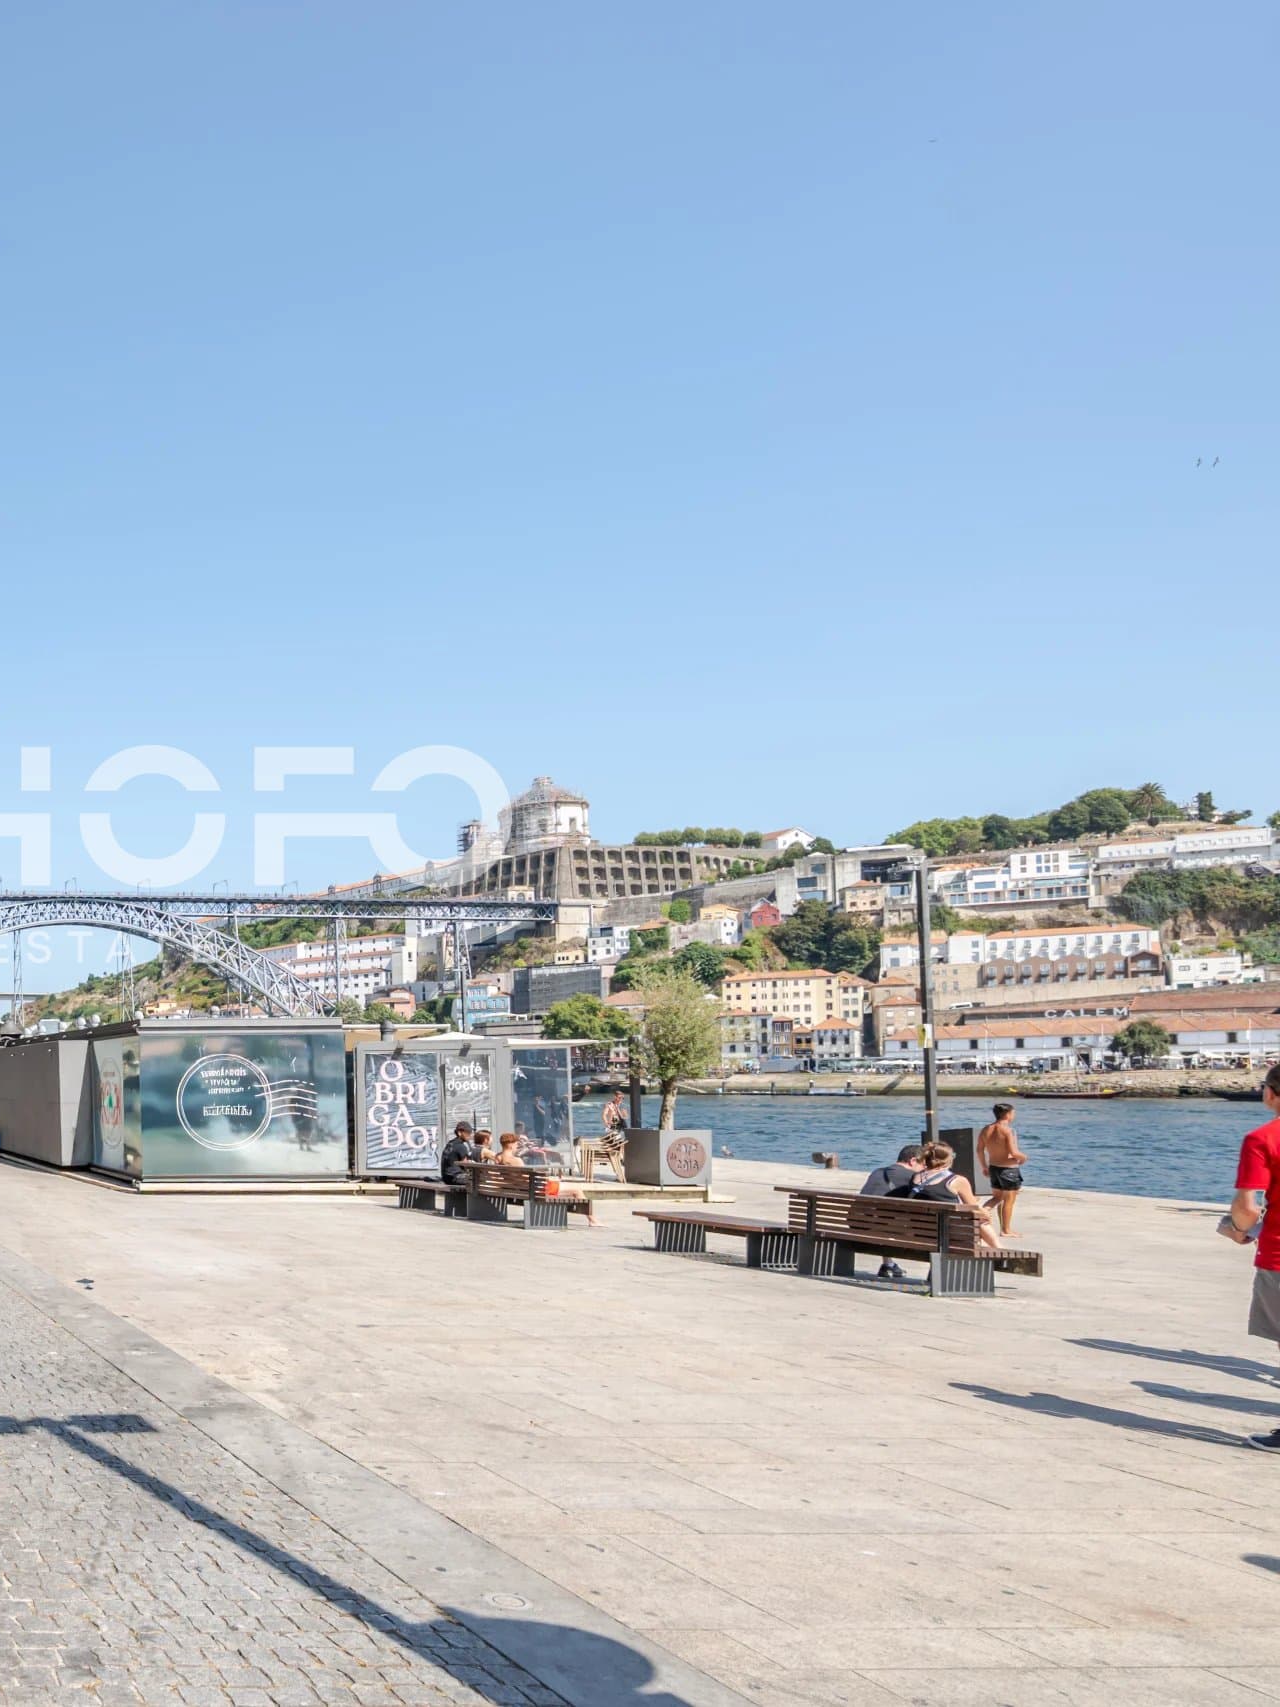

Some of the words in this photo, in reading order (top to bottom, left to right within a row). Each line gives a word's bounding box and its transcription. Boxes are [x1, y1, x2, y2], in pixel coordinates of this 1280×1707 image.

[380, 1060, 404, 1082] O
[453, 1062, 482, 1077] café
[374, 1081, 426, 1104] BRI
[368, 1104, 415, 1126] GA
[381, 1125, 438, 1149] DO!
